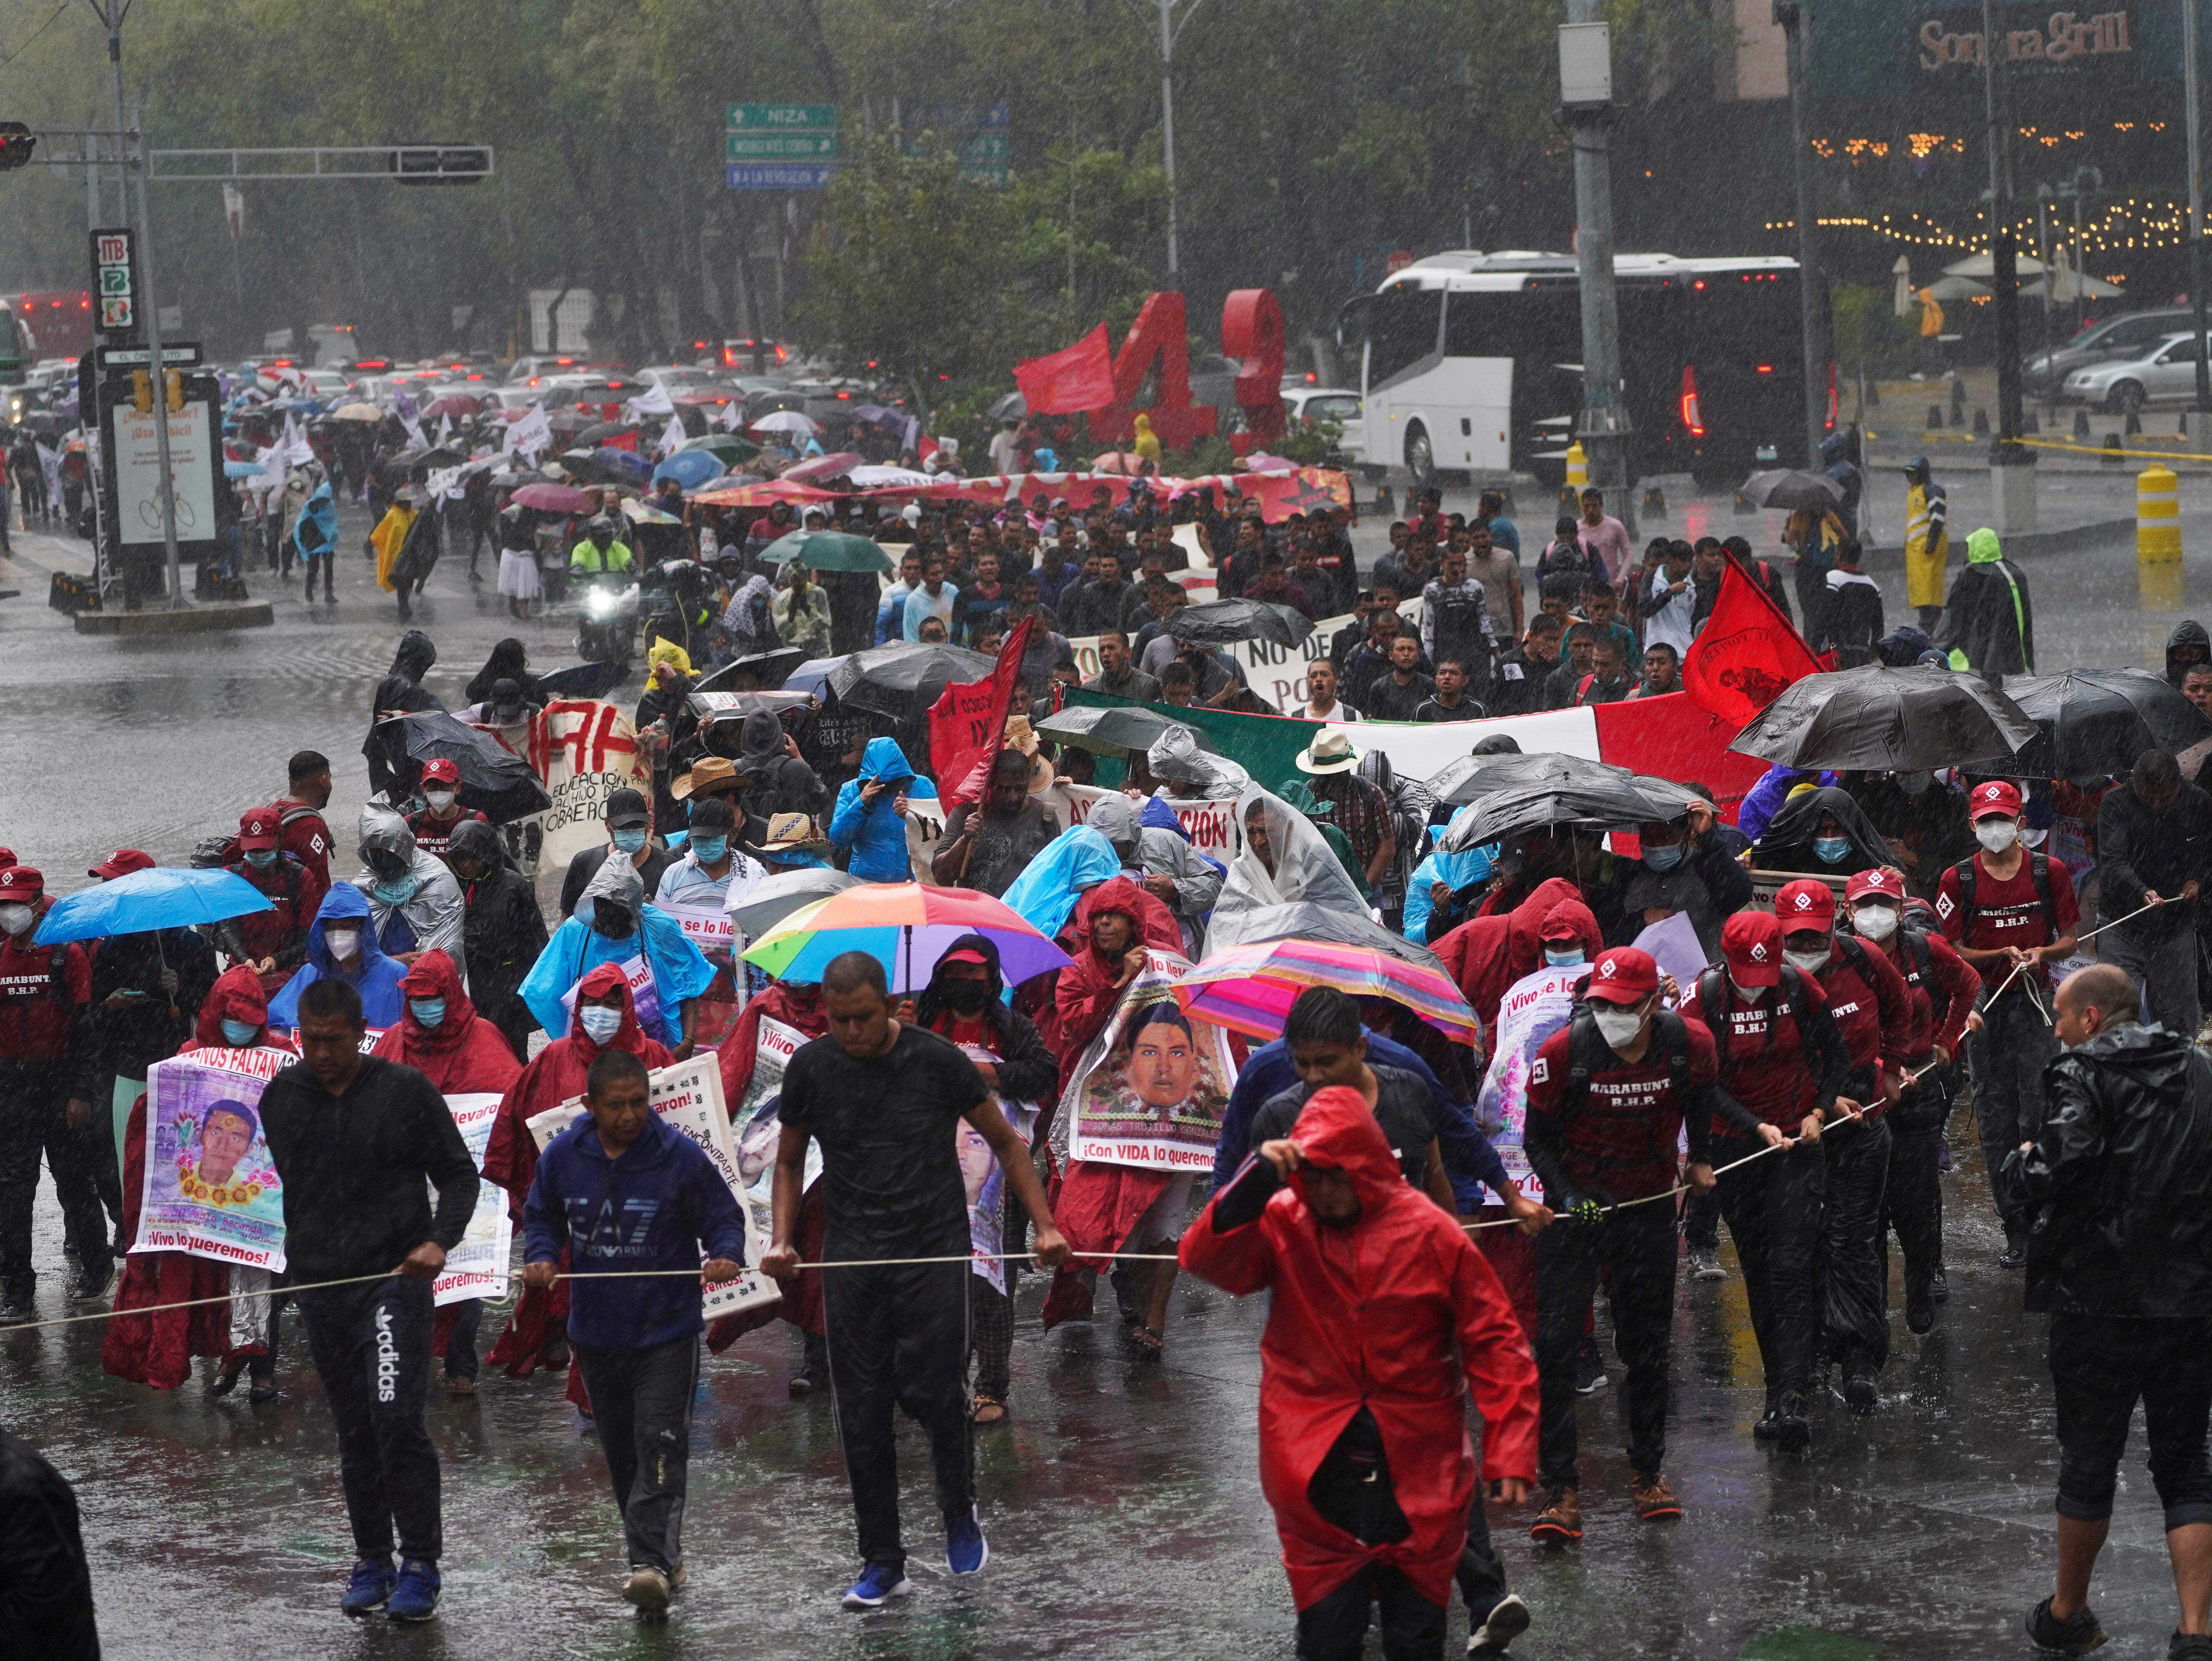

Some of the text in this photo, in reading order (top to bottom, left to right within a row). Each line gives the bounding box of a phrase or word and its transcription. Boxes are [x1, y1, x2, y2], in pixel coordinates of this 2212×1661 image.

[768, 109, 807, 123] NIZA
[1248, 637, 1287, 668] NO
[555, 798, 570, 811] AL
[572, 786, 596, 804] HIJO
[684, 920, 700, 933] se
[704, 920, 715, 934] lo
[1995, 916, 2029, 928] B.H.P.
[1150, 957, 1164, 972] lo
[7, 986, 39, 995] B.H.P.
[1507, 991, 1538, 1017] ¡Vivo
[761, 1031, 794, 1055] ¡Vivo
[200, 1047, 230, 1068] NOS
[229, 1048, 279, 1080] FALTAN
[1611, 1095, 1656, 1107] B.H.P.
[1129, 1122, 1177, 1132] TRUJILLO
[1084, 1143, 1112, 1158] ¡Con
[1117, 1145, 1150, 1160] VIDA
[1154, 1145, 1166, 1160] lo
[190, 1209, 218, 1222] Pablo
[222, 1217, 263, 1235] Baranda
[148, 1231, 270, 1265] ¡Vivo lo queremos!
[376, 1330, 400, 1403] adidas
